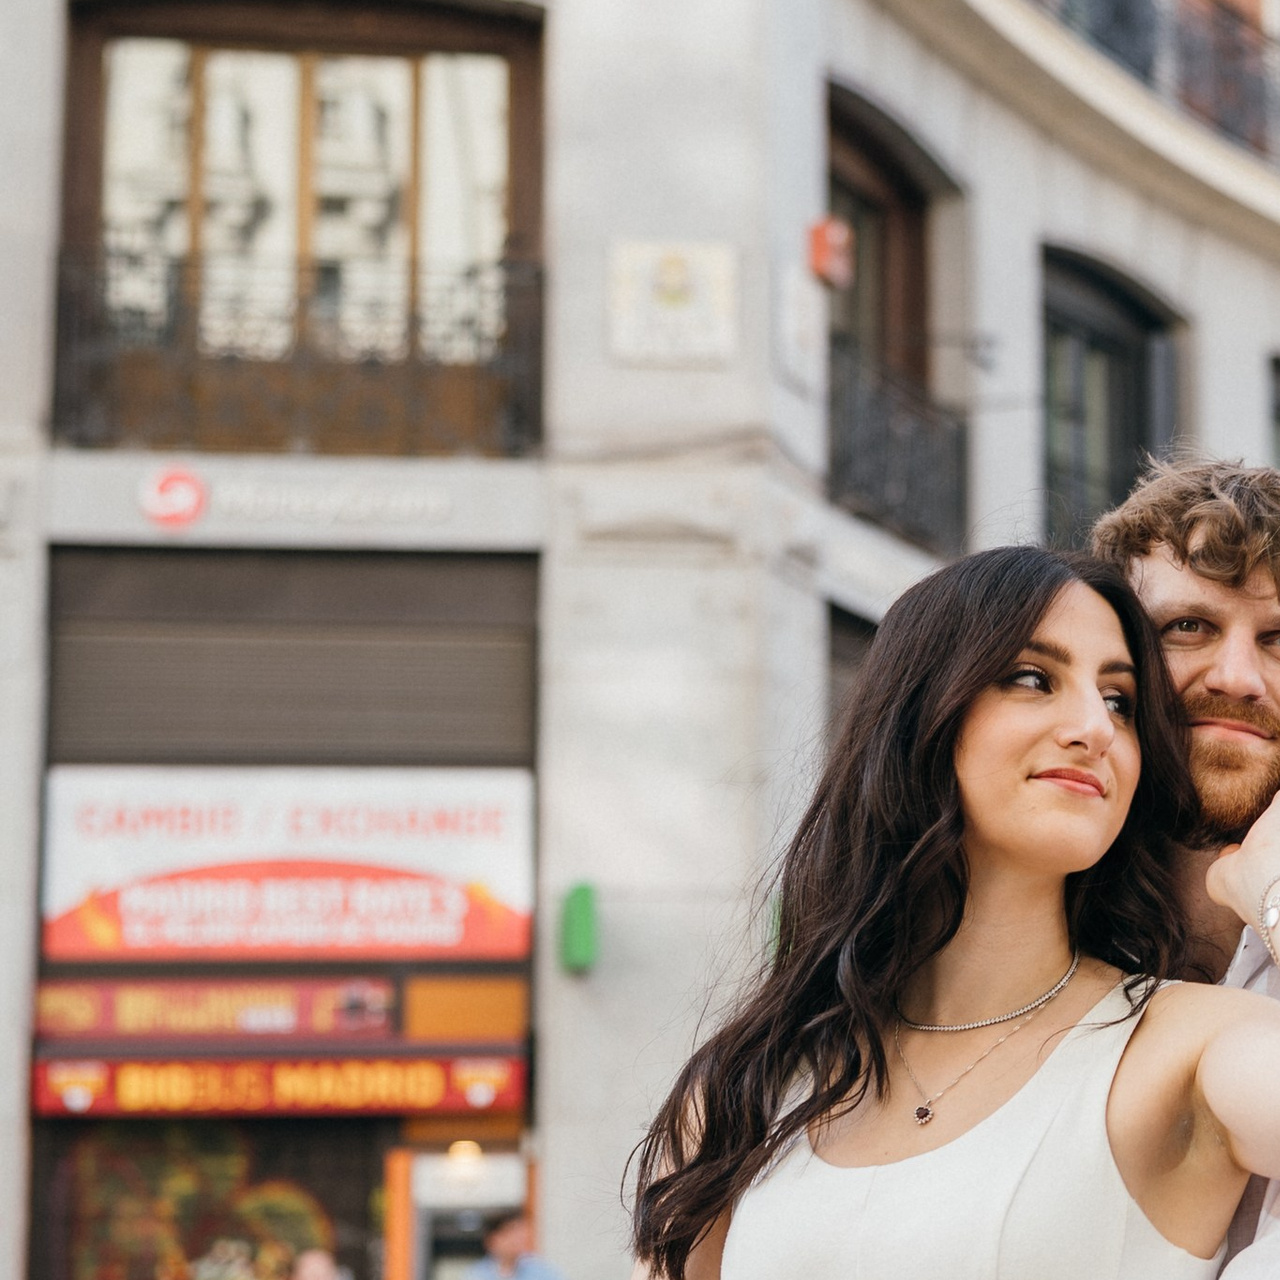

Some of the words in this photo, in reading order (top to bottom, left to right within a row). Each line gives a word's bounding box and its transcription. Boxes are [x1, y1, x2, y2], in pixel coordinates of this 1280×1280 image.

[74, 800, 243, 842] CAMBIO
[287, 800, 506, 841] EXCHANGE
[272, 1060, 447, 1109] MADRID
